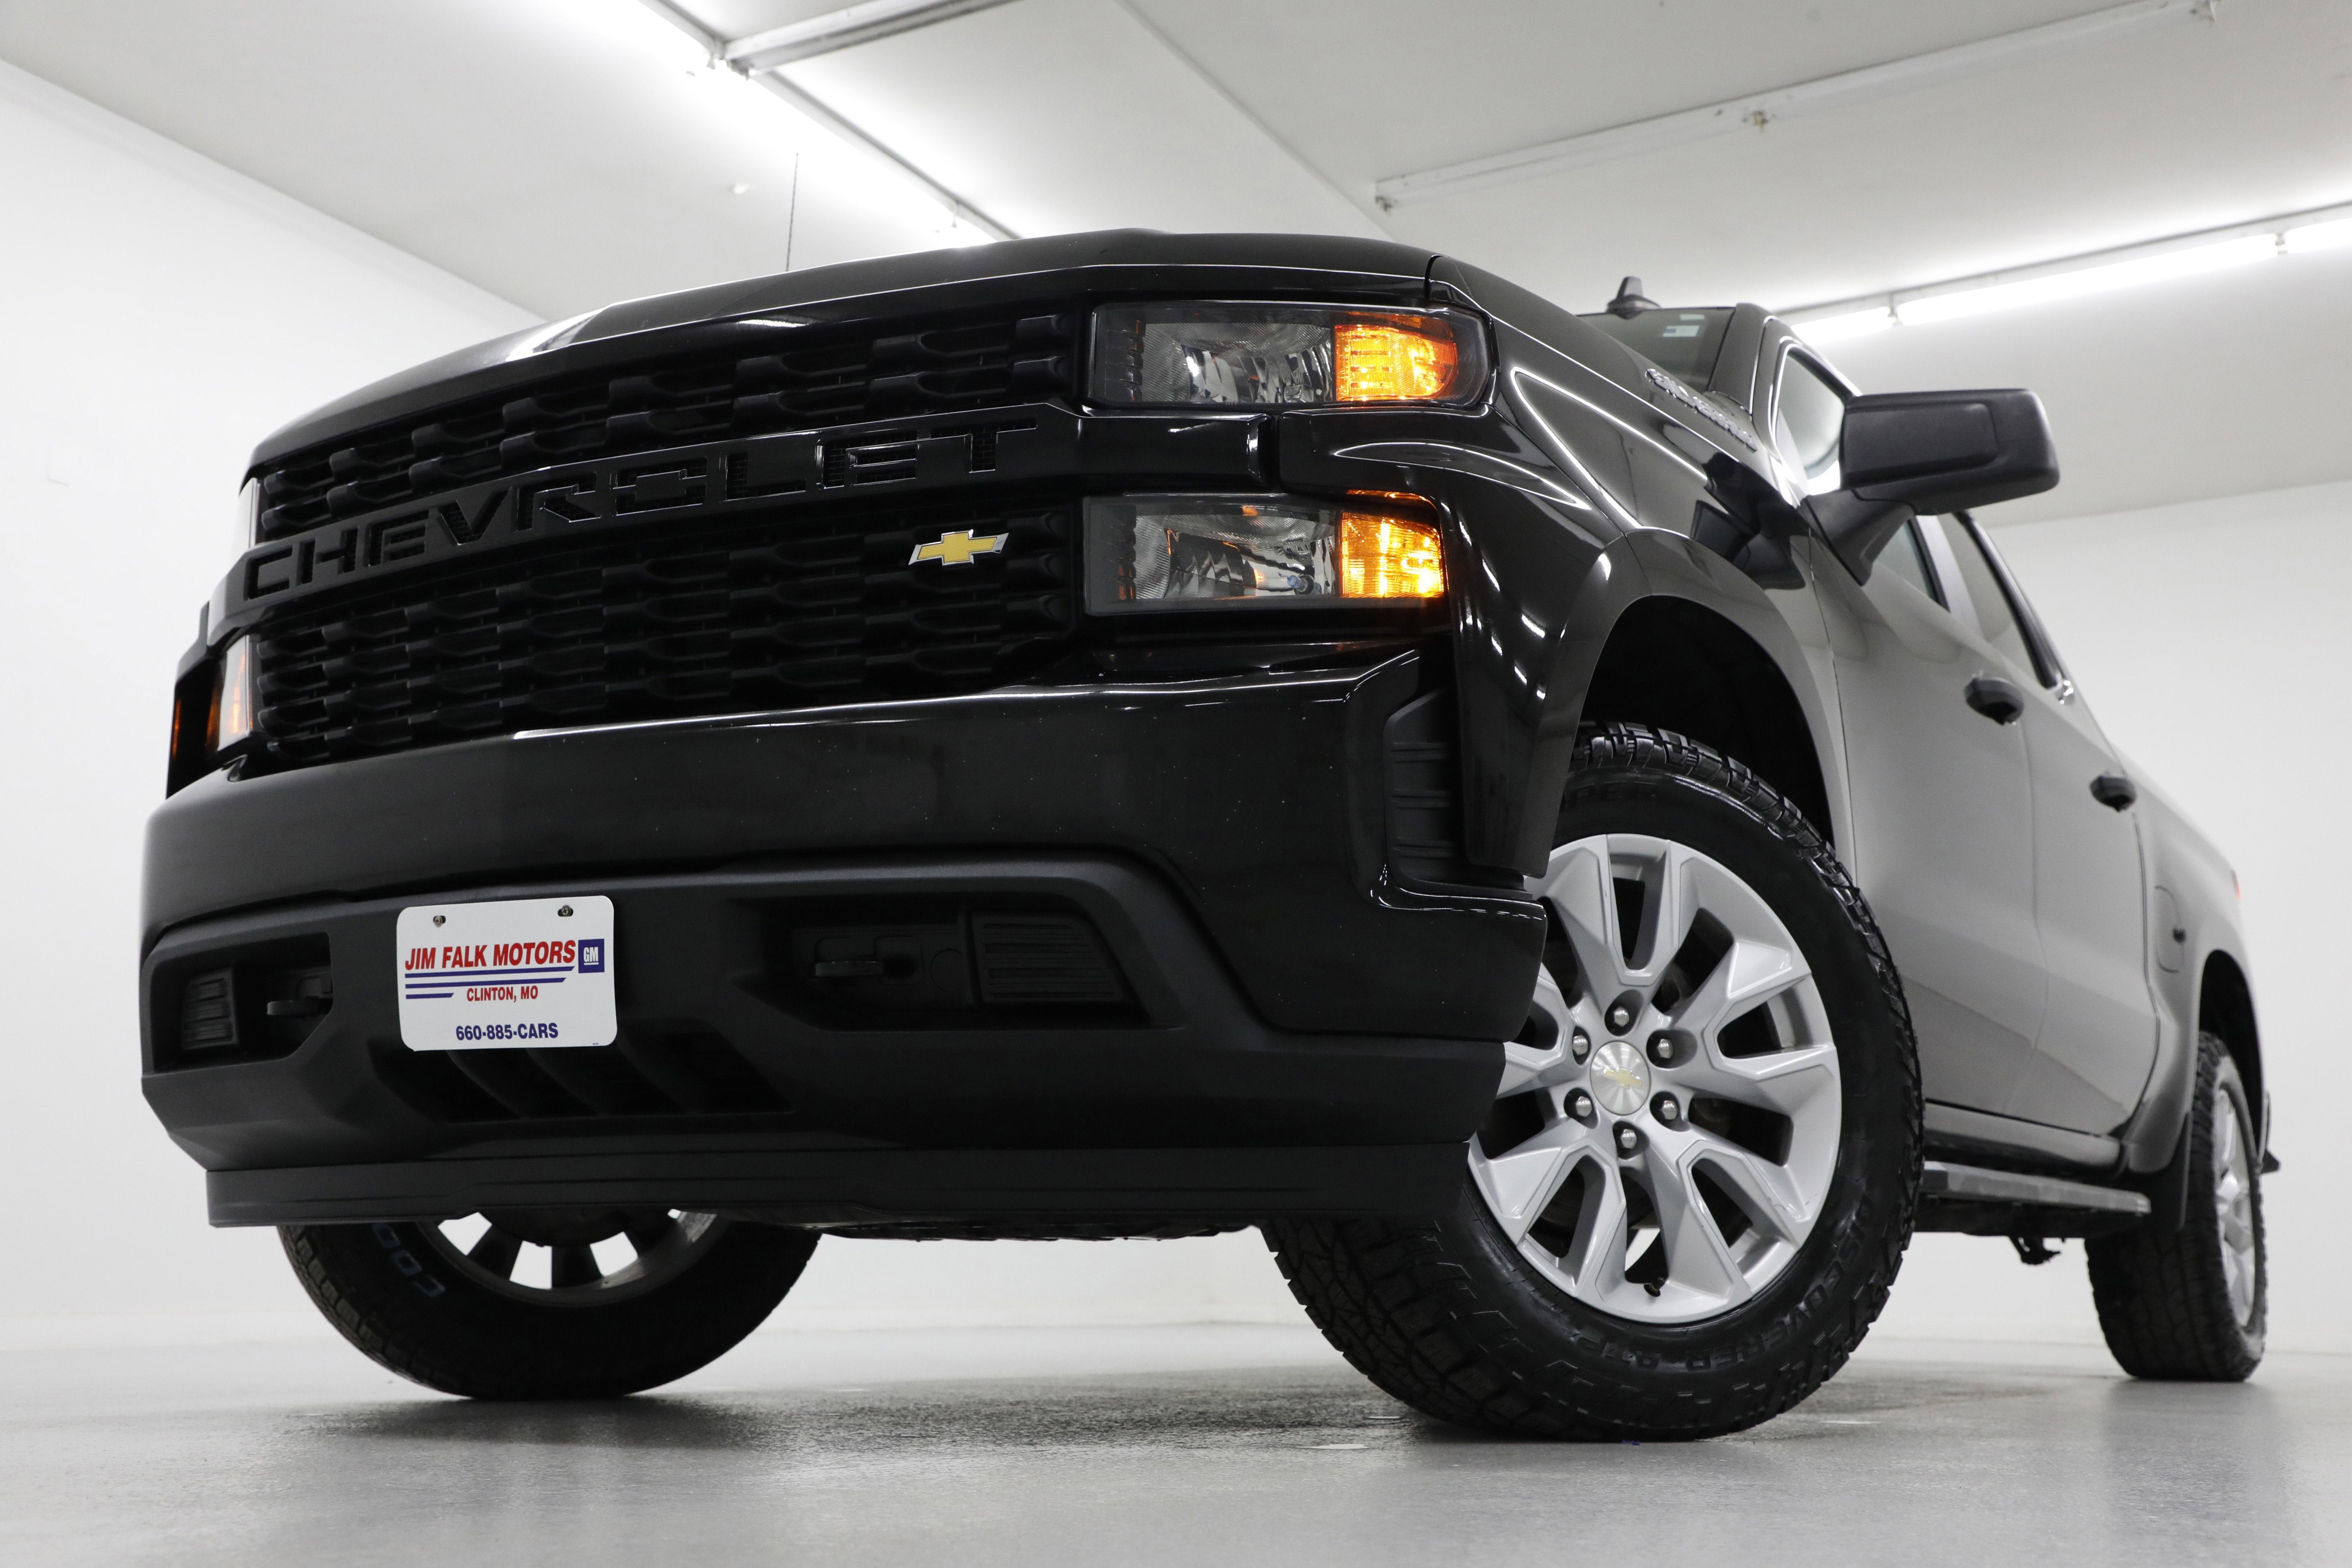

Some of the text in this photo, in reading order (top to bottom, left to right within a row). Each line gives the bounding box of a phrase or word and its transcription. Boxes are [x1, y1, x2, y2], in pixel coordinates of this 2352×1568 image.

[244, 418, 1038, 601] CHEVROLET
[405, 940, 576, 970] JIM FALK MOTORS
[584, 946, 599, 965] GM
[467, 986, 538, 1002] CLINTON, MO
[456, 1022, 558, 1040] 660-885-CARS
